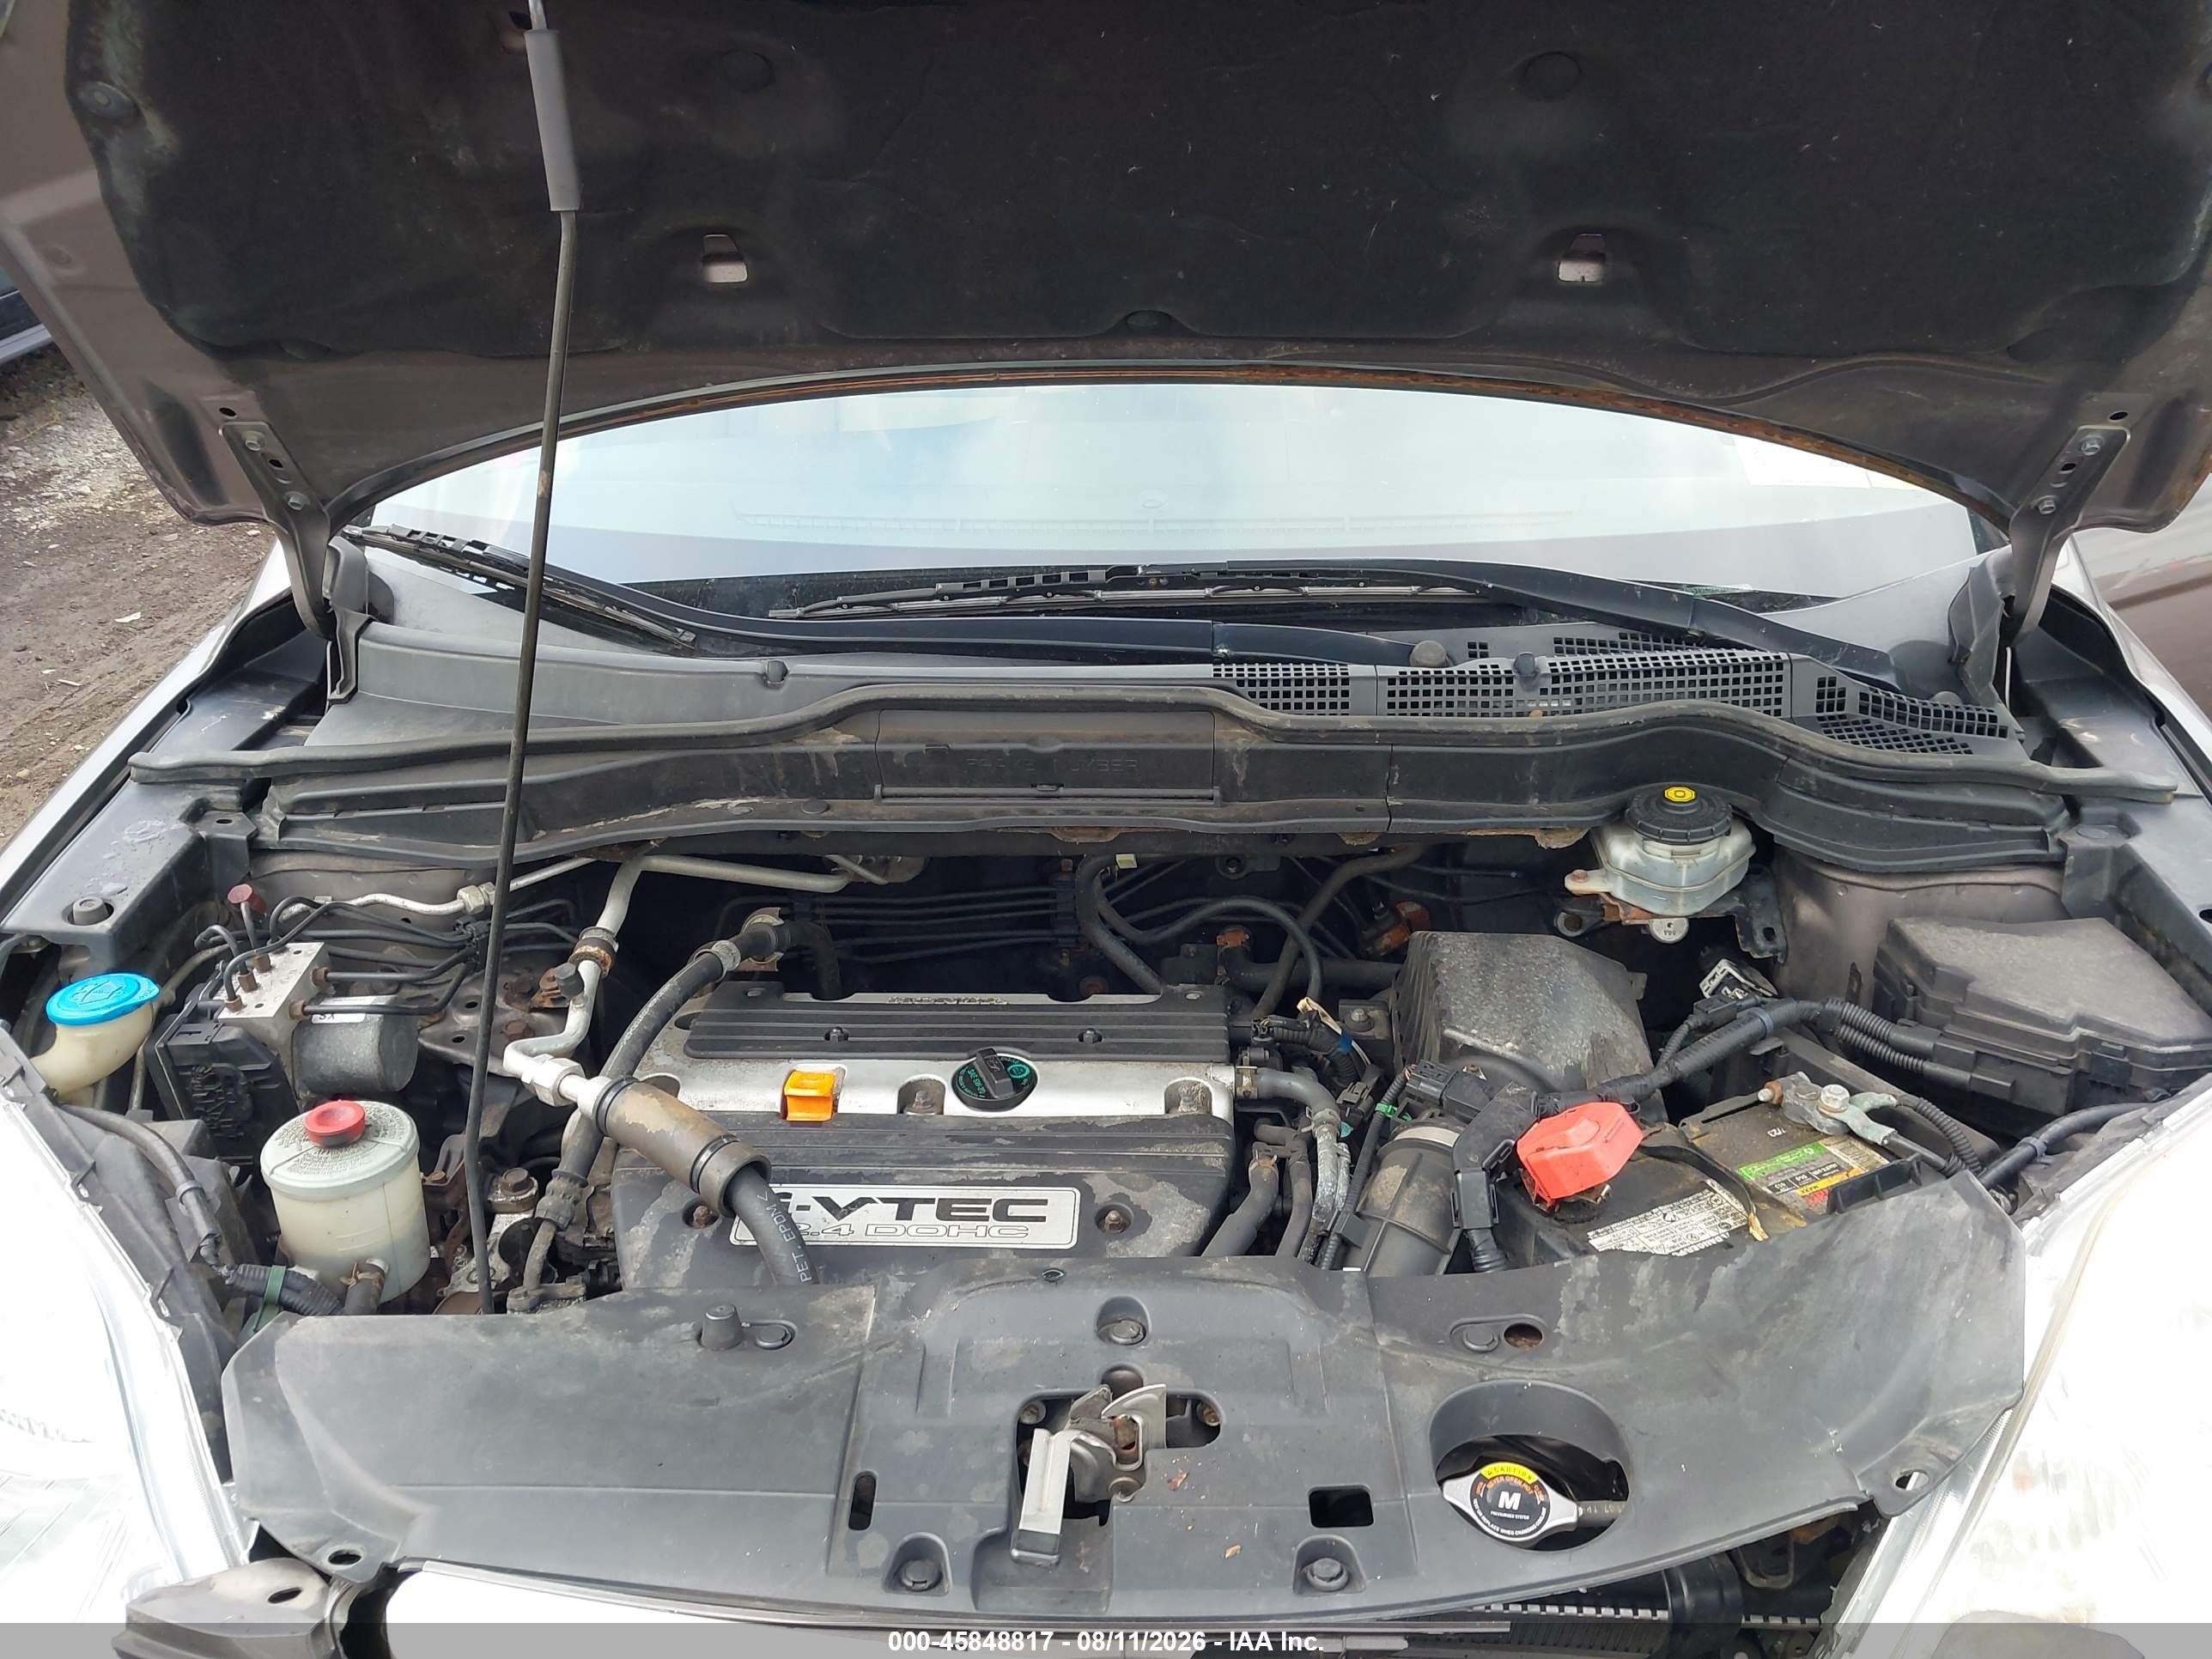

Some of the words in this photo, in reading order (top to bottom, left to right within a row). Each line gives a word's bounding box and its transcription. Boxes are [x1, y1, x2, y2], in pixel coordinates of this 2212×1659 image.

[865, 1223, 1029, 1238] DOHC
[1494, 1465, 1532, 1480] CAUTION
[1498, 1491, 1522, 1510] M
